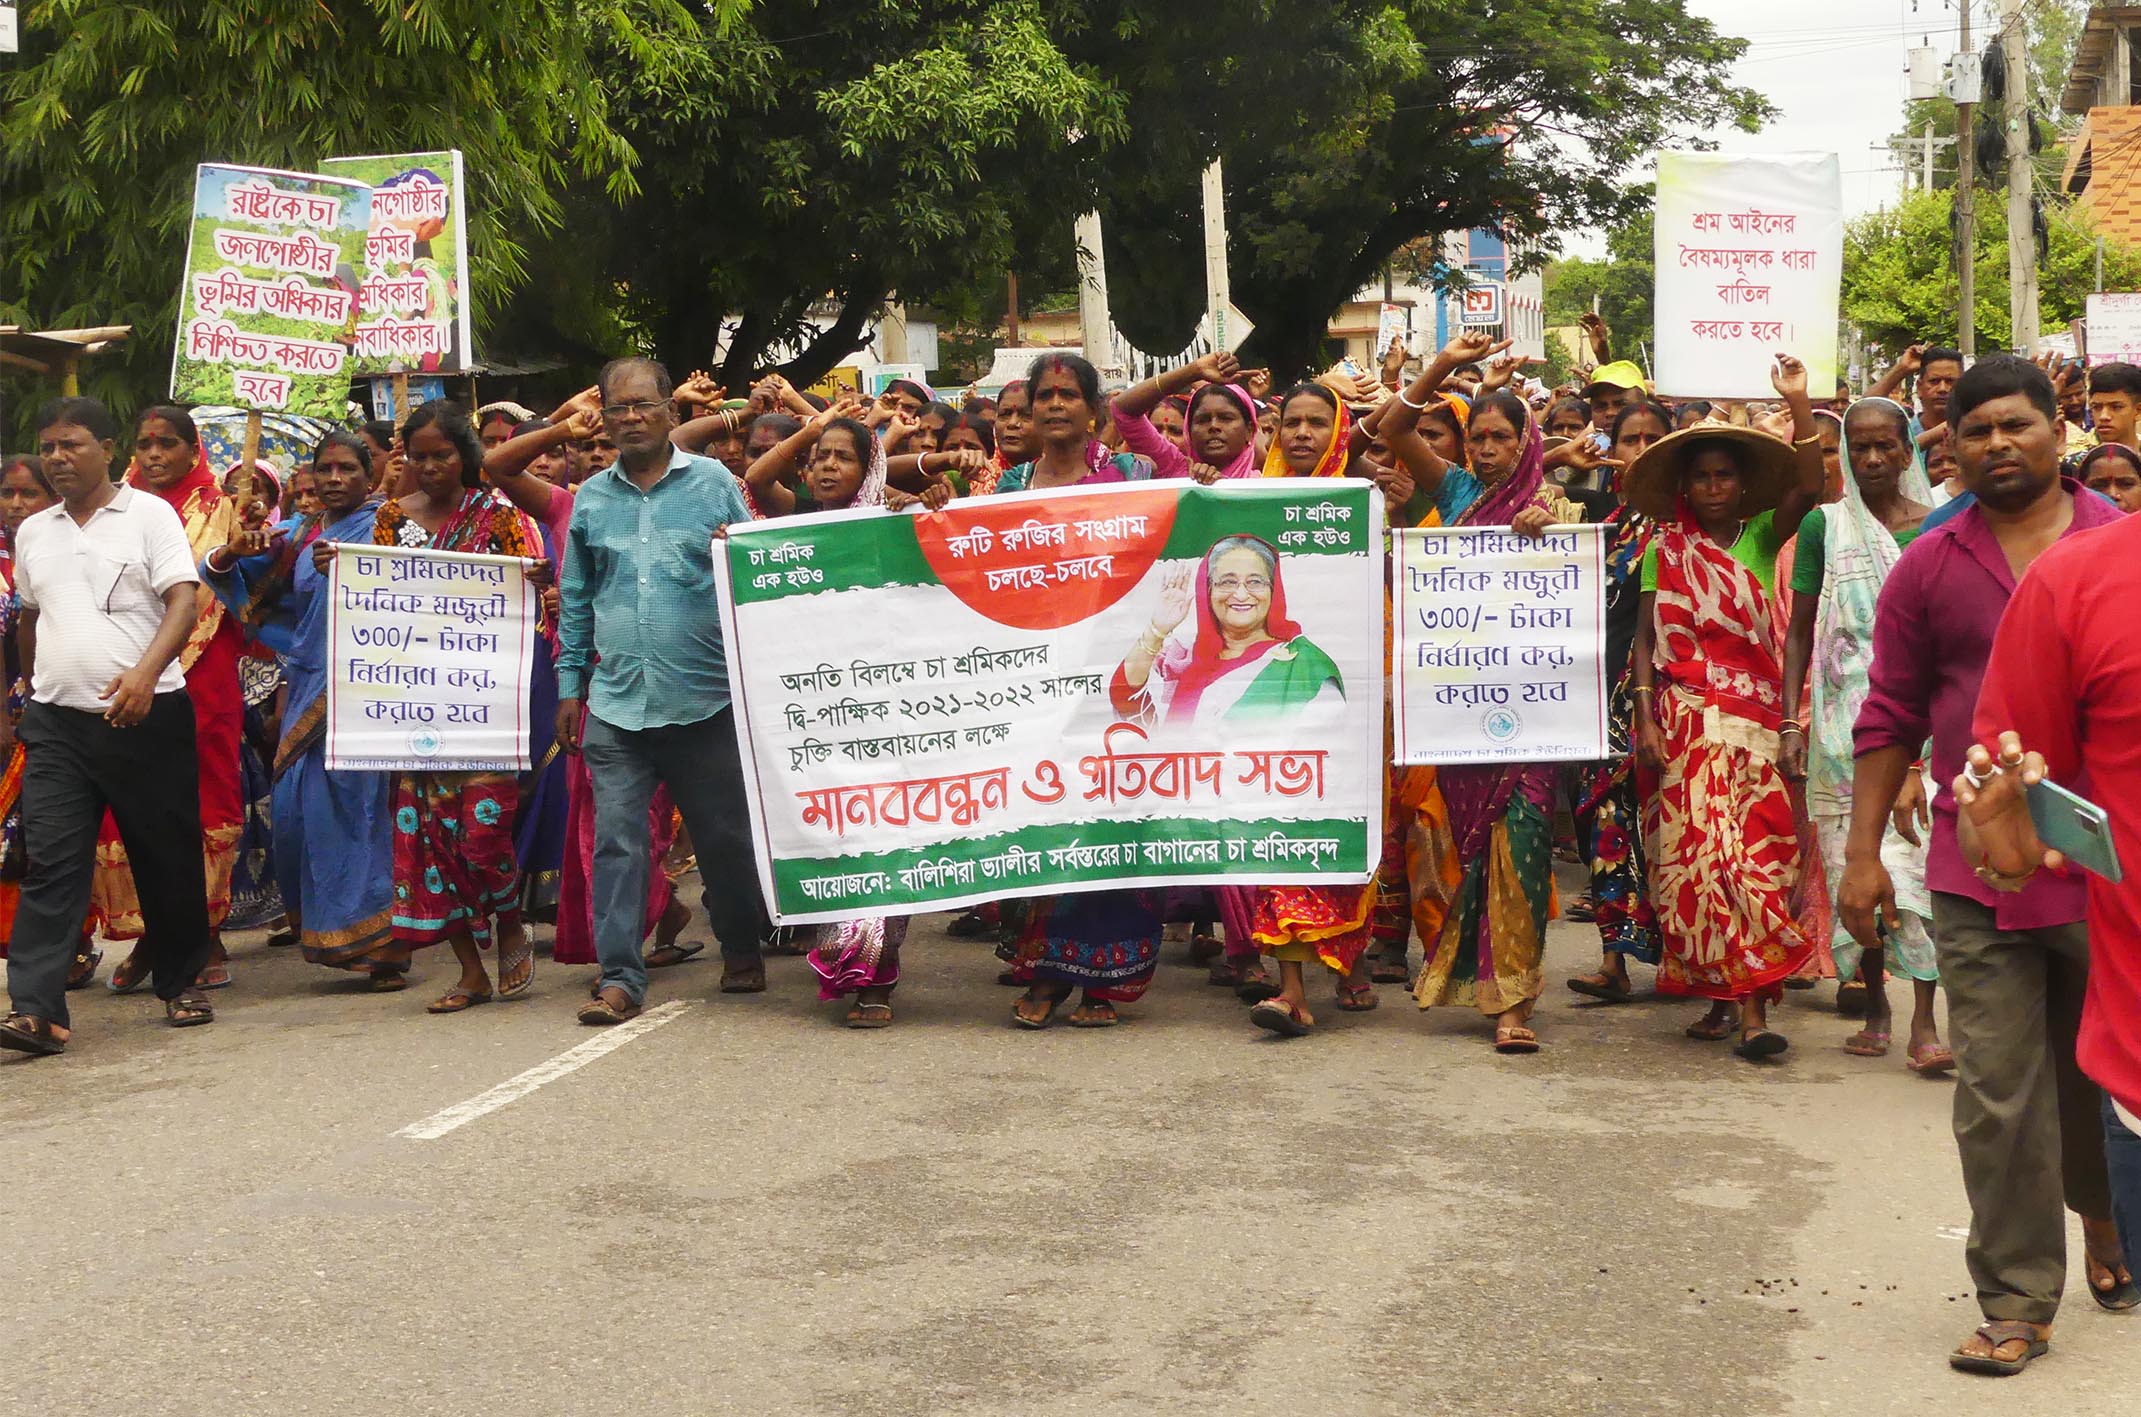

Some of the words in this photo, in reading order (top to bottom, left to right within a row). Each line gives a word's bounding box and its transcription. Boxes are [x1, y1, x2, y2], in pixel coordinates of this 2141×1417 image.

[231, 185, 304, 219] রাষ্ট্রকে
[307, 199, 335, 226] চা
[372, 180, 443, 215] নগোষ্ঠীর
[1692, 211, 1722, 233] শ্রম
[1728, 207, 1796, 235] আইনের
[220, 233, 335, 272] জনগোষ্ঠীর
[366, 227, 411, 268] ভূমির
[1678, 243, 1774, 276] বৈষম্যমূলক
[1781, 249, 1816, 270] ধারা
[199, 272, 258, 314] ভূমির
[262, 281, 347, 320] অধিকার
[1716, 278, 1771, 305] বাতিল
[1690, 319, 1744, 340] করতে
[192, 322, 272, 360] নিশ্চিত
[272, 341, 341, 370] করতে
[238, 375, 285, 403] হবে
[1283, 505, 1302, 522] চা
[1305, 501, 1353, 523] শ্রমিক
[945, 525, 994, 559] রুটি
[999, 519, 1067, 552] রুজির
[1073, 514, 1149, 543] সংগ্রাম
[1278, 531, 1308, 547] এক
[1311, 525, 1351, 548] হউও
[1422, 535, 1450, 555] চা
[1459, 530, 1580, 559] শ্রমিকদের
[747, 548, 766, 566] চা
[768, 542, 815, 564] শ্রমিক
[355, 556, 383, 576] চা
[391, 556, 505, 586] শ্রমিকদের
[752, 572, 782, 589] এক
[783, 565, 824, 589] হউও
[984, 555, 1115, 592] চলছে-চলবে
[1408, 566, 1494, 593] দৈনিক
[1502, 564, 1582, 600] মজুরী
[341, 585, 424, 613] দৈনিক
[433, 593, 509, 626] মজুরী
[1419, 604, 1498, 633] ৩০০/-
[1508, 602, 1573, 629] টাকা
[351, 624, 429, 653] ৩০০/-
[438, 627, 499, 653] টাকা
[779, 663, 844, 694] অনতি
[849, 659, 917, 688] বিলম্বে
[923, 656, 947, 679] চা
[952, 644, 1050, 676] শ্রমিকদের
[1416, 639, 1511, 671] নির্ধারণ
[348, 658, 438, 689] নির্ধারণ
[899, 684, 1035, 720] ২০২১-২০২২
[1040, 673, 1103, 698] সালের
[1433, 684, 1511, 709] করতে
[1519, 681, 1568, 703] হবে
[363, 700, 437, 724] করতে
[445, 703, 491, 724] হবে
[788, 737, 833, 773] চুক্তি
[838, 730, 957, 760] বাস্তবায়নের
[795, 767, 1011, 836] মানববন্ধন
[1022, 760, 1065, 803] ও
[1078, 722, 1224, 805] প্রতিবাদ
[1233, 750, 1329, 799] সভা
[898, 857, 976, 891] বালিশিরা
[979, 845, 1041, 879] ভ্যালীর
[1047, 838, 1120, 870] সর্বস্তরের
[1122, 840, 1138, 865] চা
[1142, 838, 1219, 864] বাগানের
[1225, 836, 1247, 862] চা
[1252, 831, 1341, 870] শ্রমিকবৃন্দ
